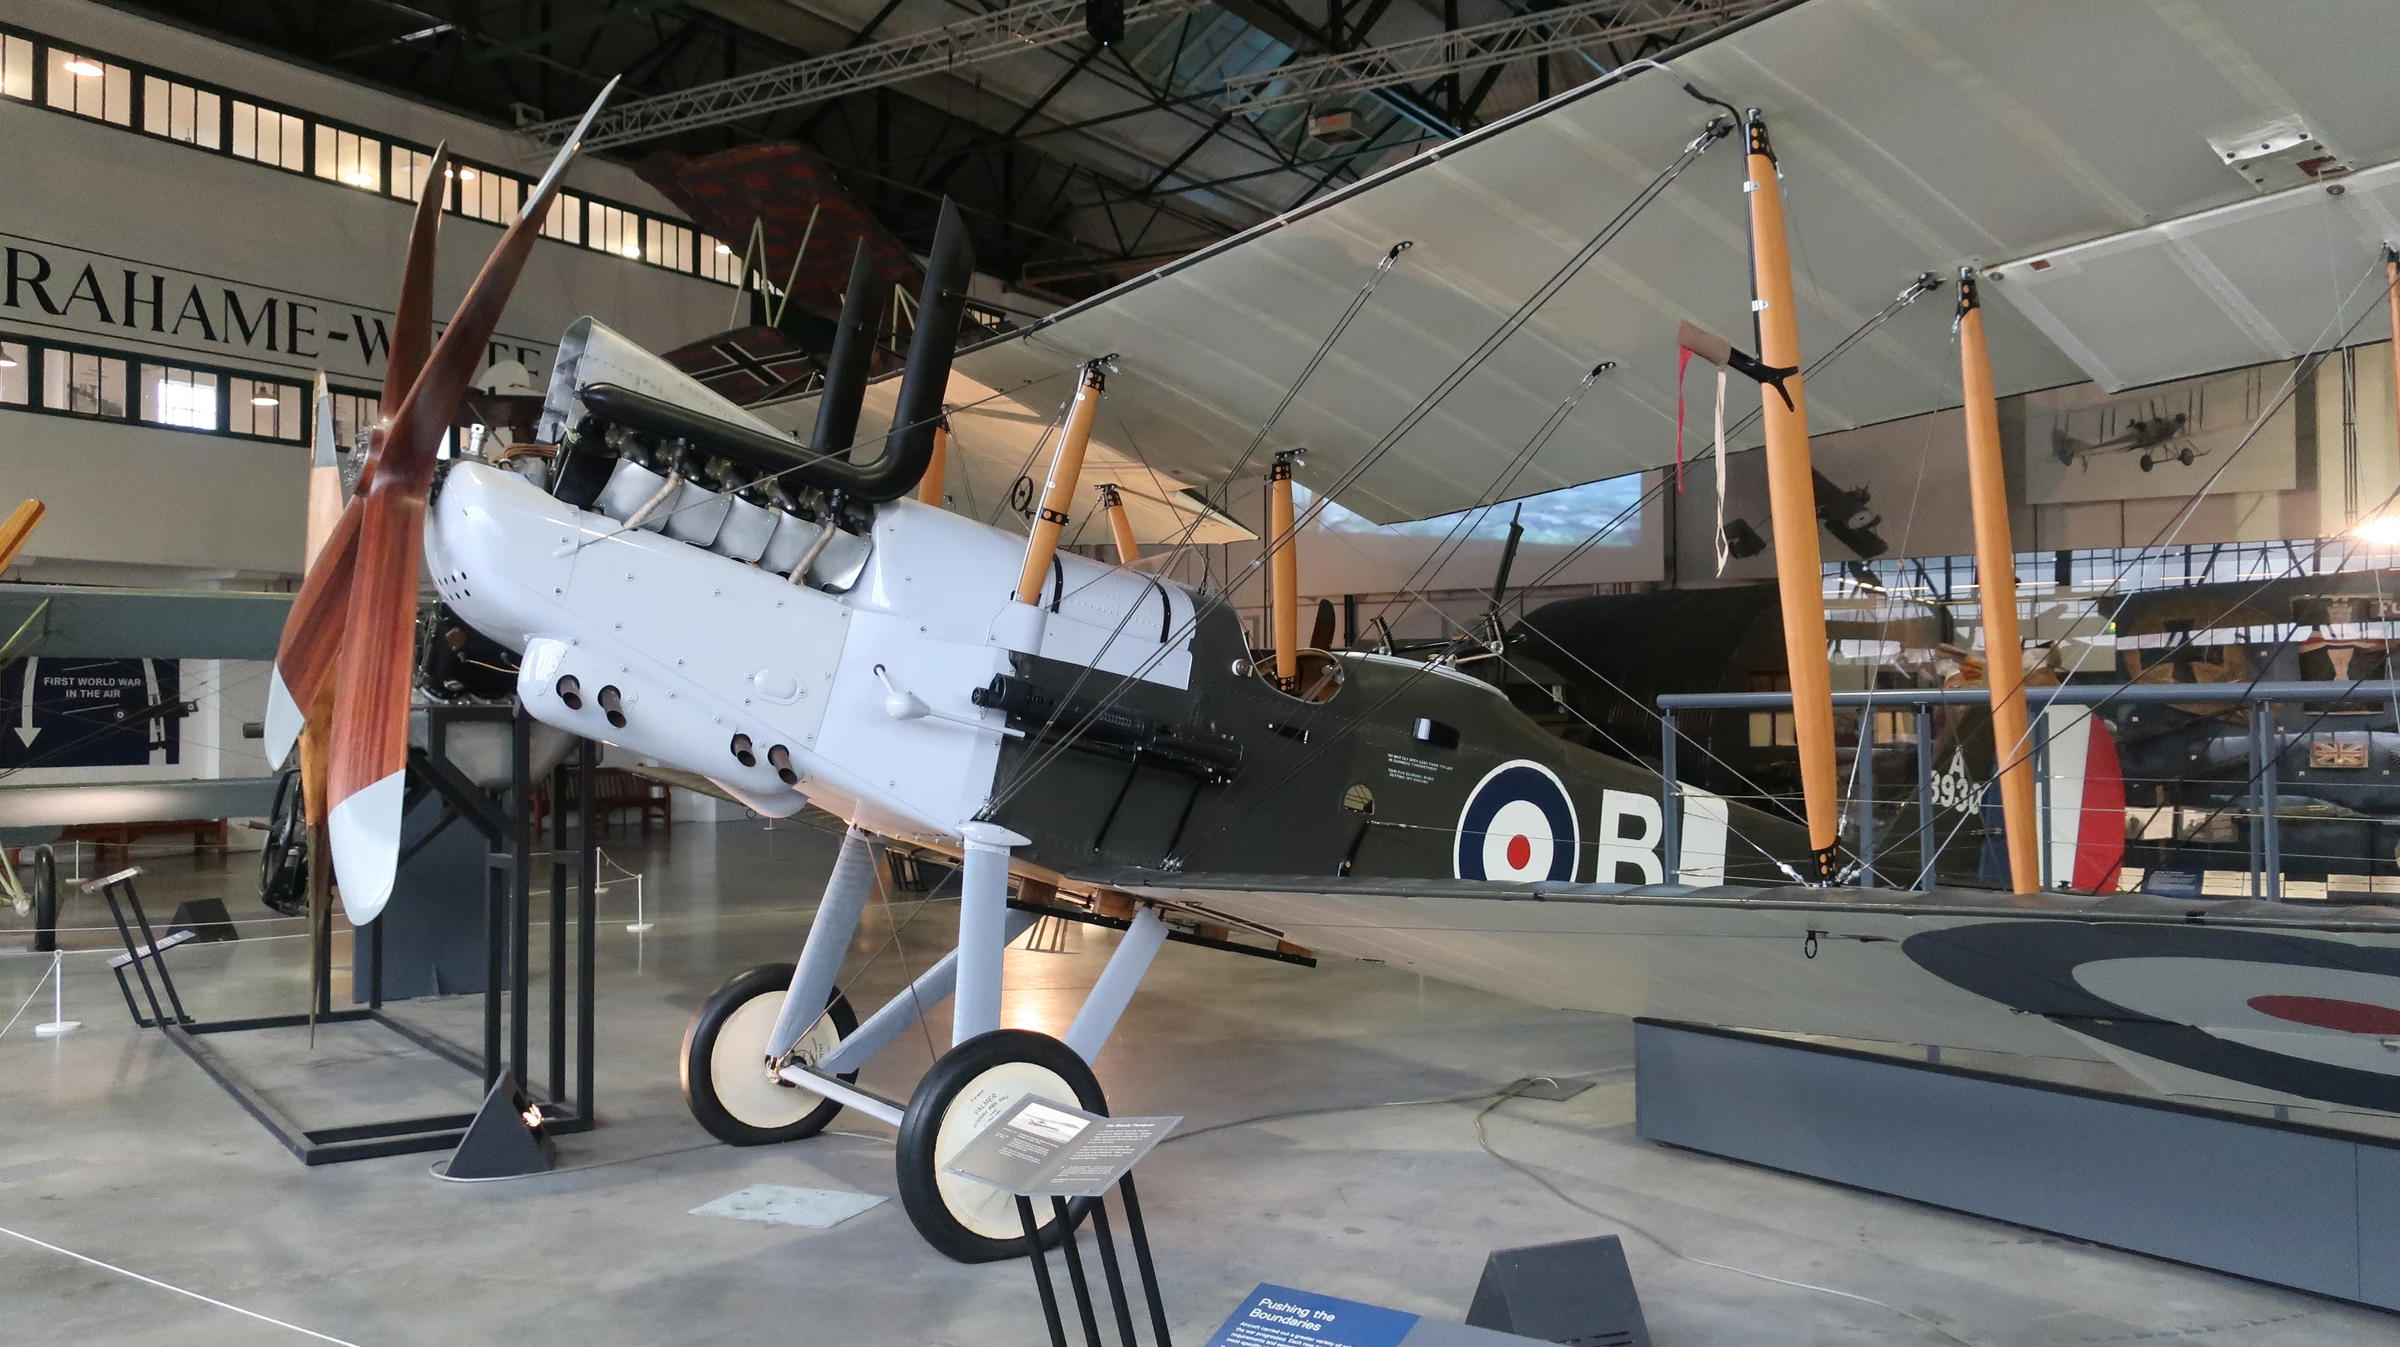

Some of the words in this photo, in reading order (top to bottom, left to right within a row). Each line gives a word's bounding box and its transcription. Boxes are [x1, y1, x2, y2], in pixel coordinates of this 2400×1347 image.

[43, 677, 75, 686] FIRST
[78, 677, 116, 686] WORLD
[117, 678, 141, 686] WAR
[65, 689, 77, 698] IN
[79, 689, 100, 698] THE
[103, 689, 121, 698] AIR
[1949, 744, 1965, 779] A
[973, 1092, 998, 1116] PALMER
[1248, 1307, 1323, 1332] Boundaries
[1257, 1297, 1311, 1317] Pushing
[1313, 1309, 1336, 1323] the
[1240, 1321, 1261, 1330] Aircraft
